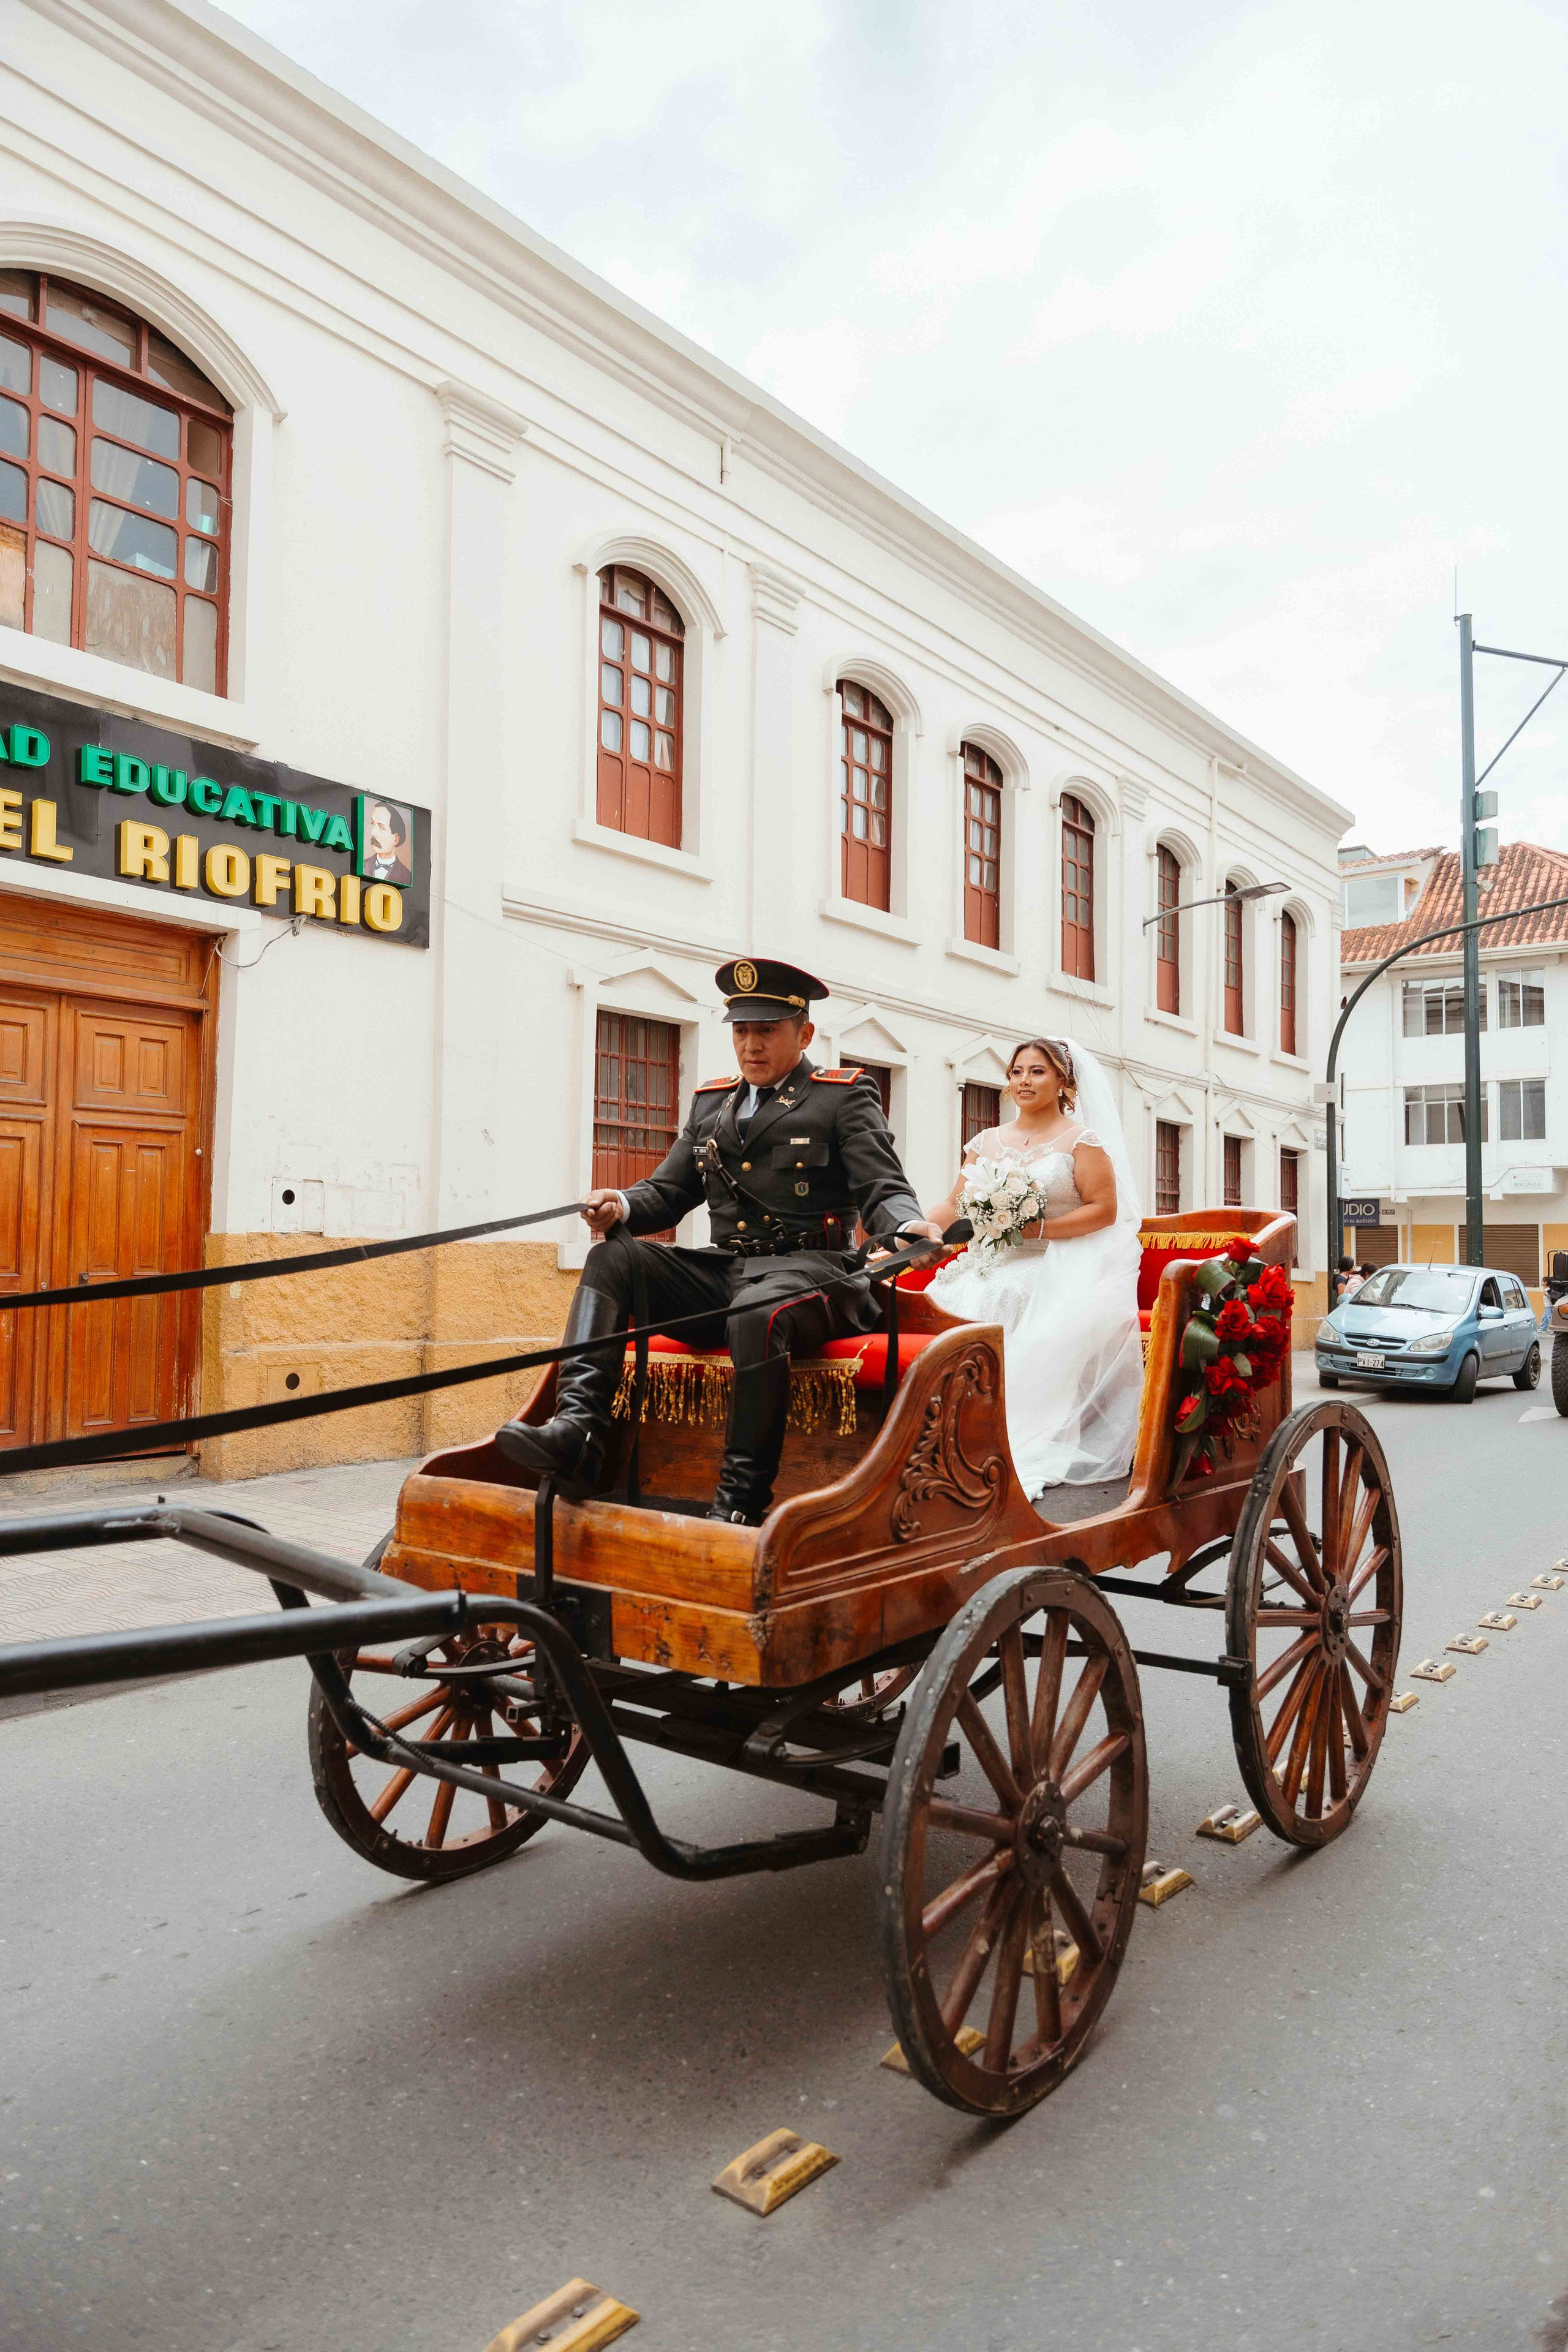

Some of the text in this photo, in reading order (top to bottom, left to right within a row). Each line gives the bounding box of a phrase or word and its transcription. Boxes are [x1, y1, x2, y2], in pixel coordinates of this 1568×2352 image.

[81, 744, 354, 852] EDUCATIVA
[0, 788, 402, 932] EL RIOFRIO
[1357, 1358, 1384, 1368] PVI-274
